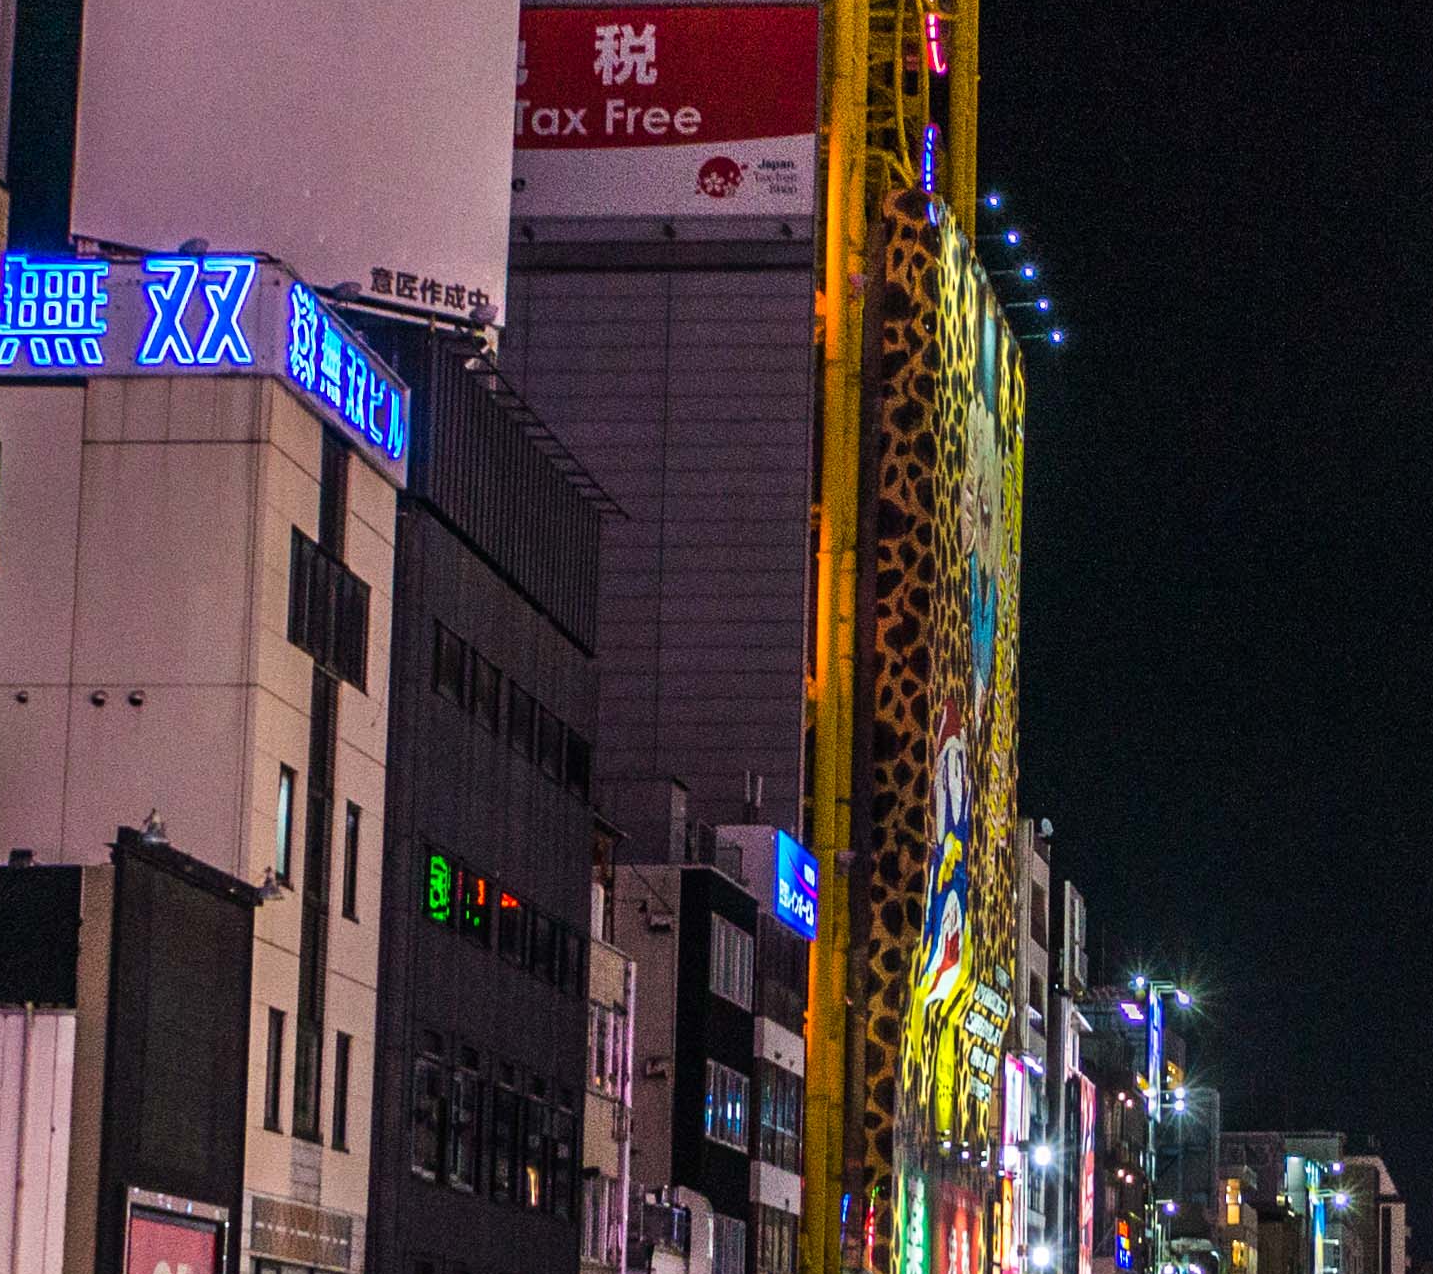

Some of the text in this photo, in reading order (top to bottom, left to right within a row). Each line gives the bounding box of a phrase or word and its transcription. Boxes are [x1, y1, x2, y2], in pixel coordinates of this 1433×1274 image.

[592, 22, 660, 88] 税
[514, 97, 703, 137] Tax Free
